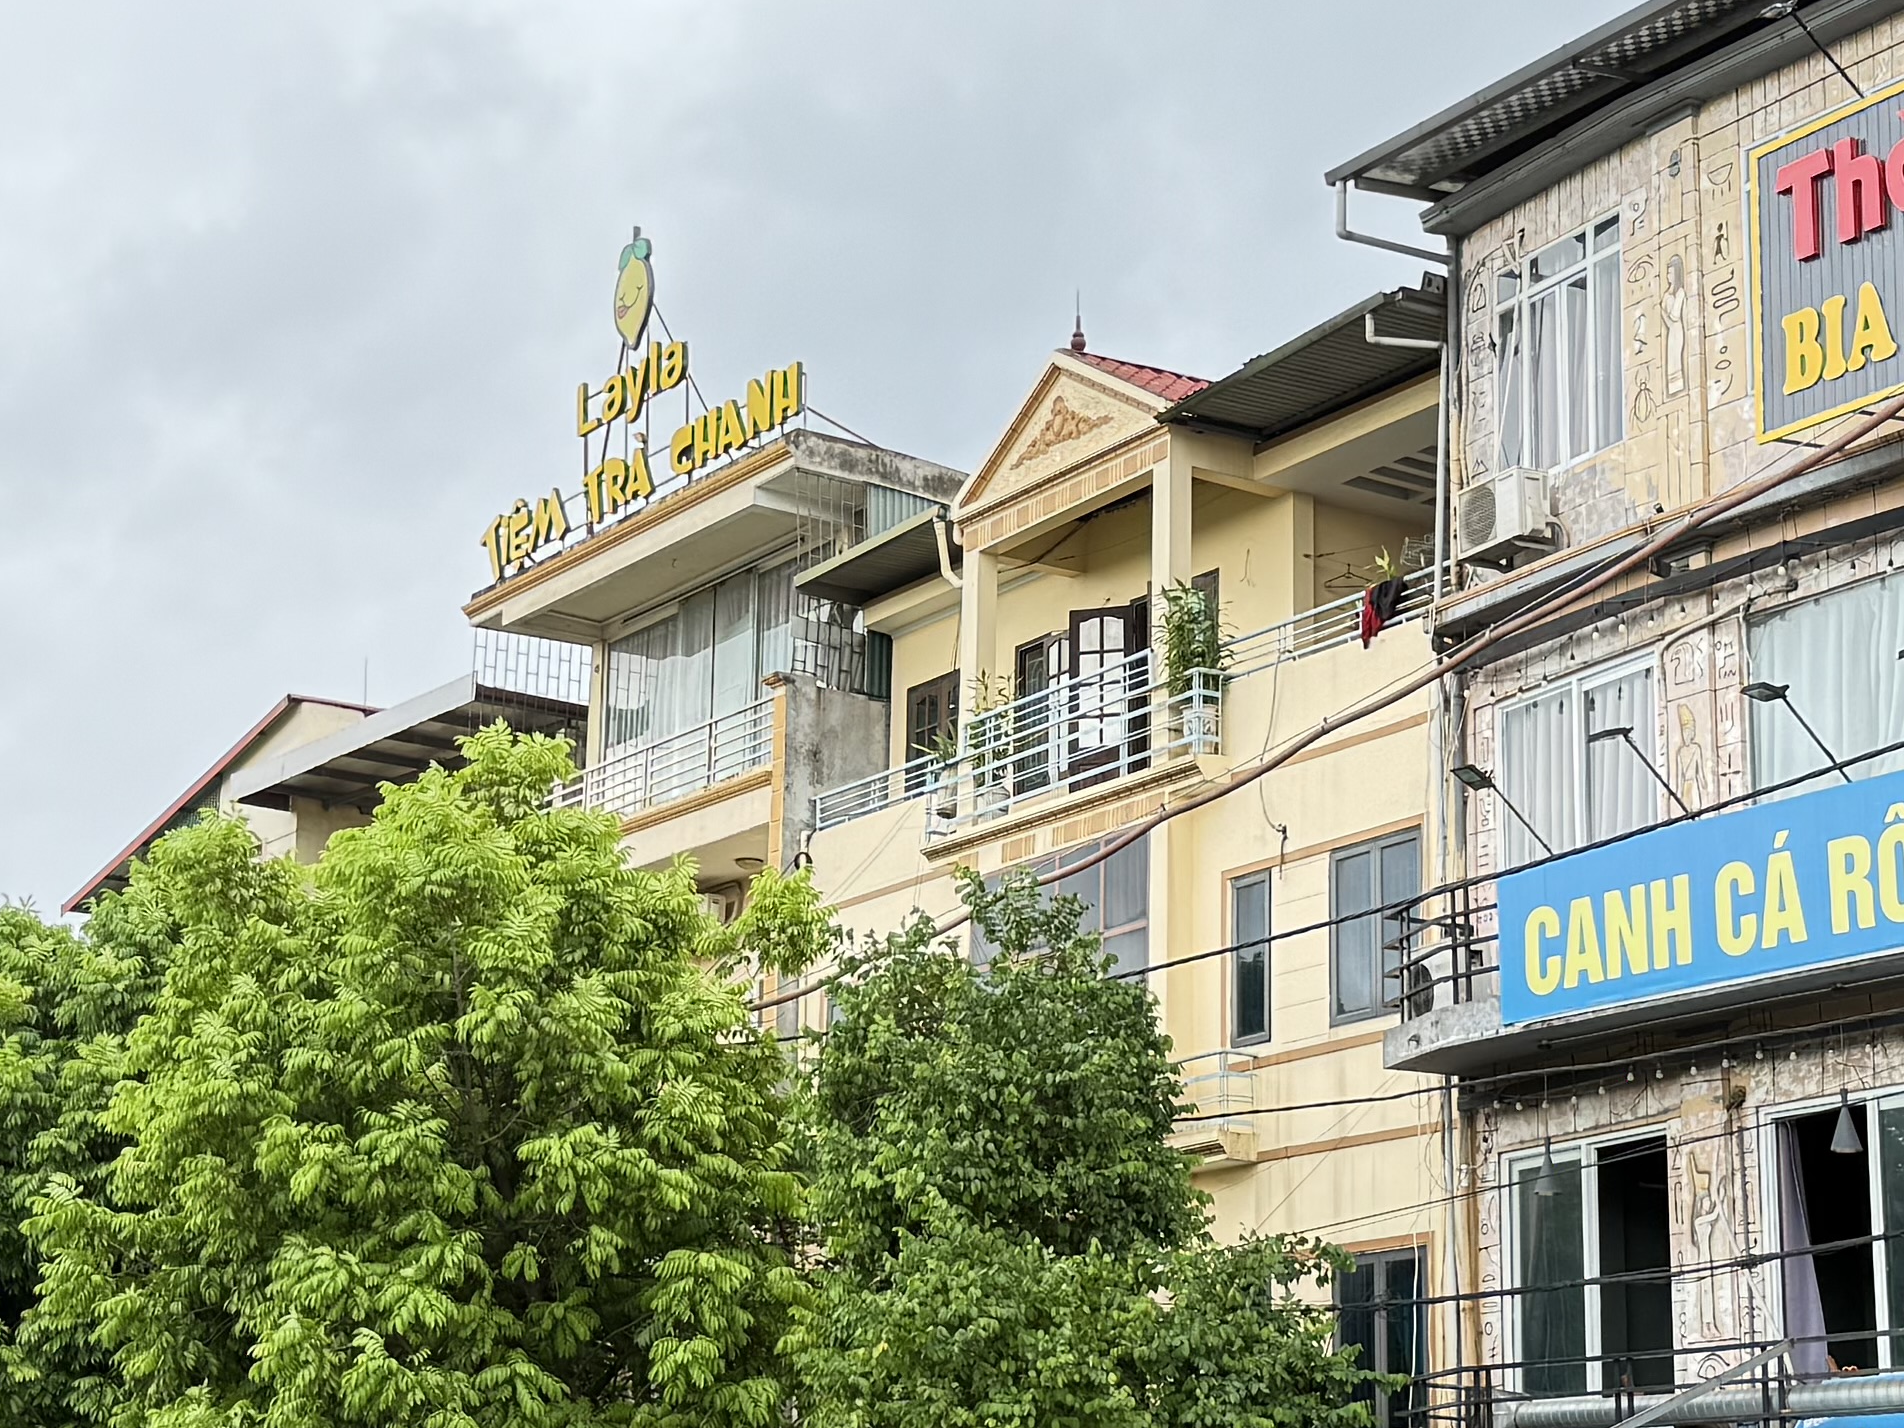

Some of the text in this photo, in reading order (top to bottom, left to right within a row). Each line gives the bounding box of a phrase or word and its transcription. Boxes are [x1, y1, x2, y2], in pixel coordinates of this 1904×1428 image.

[577, 341, 688, 437] Layla
[1780, 281, 1896, 395] BIA
[583, 432, 655, 523] TRÀ
[670, 362, 803, 475] CHANH
[1523, 874, 1692, 996] CANH
[1715, 829, 1807, 956] CÁ
